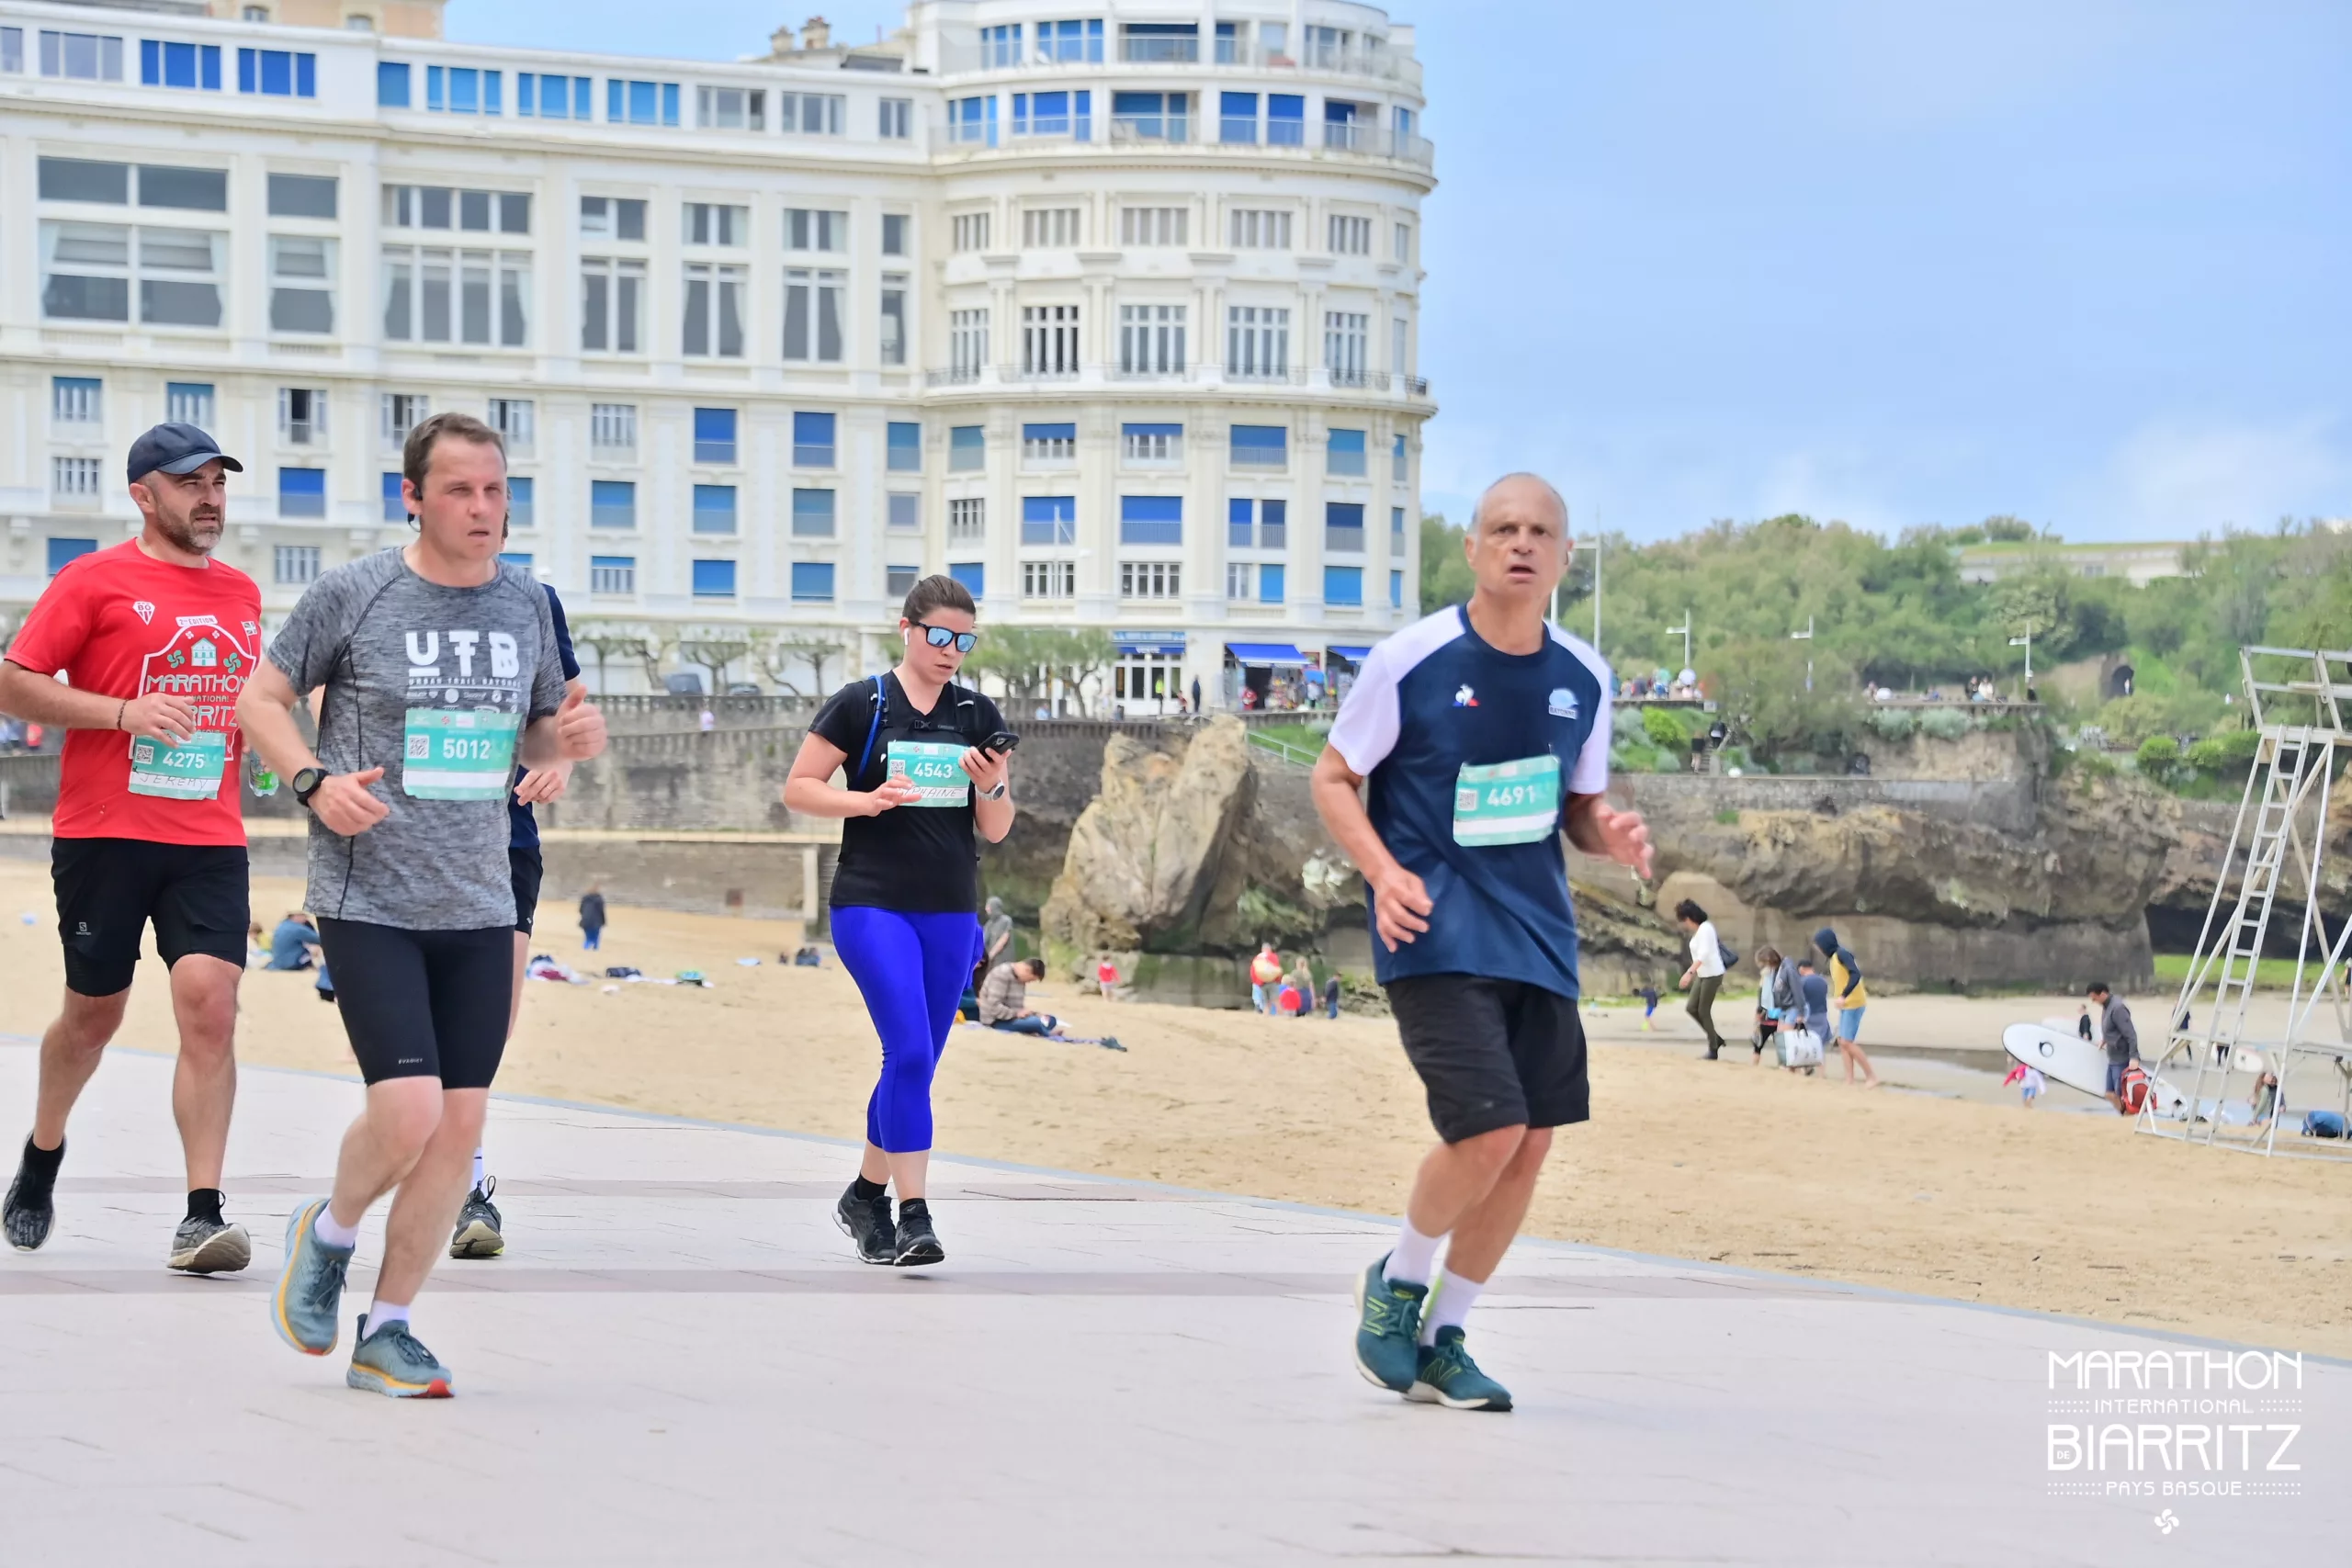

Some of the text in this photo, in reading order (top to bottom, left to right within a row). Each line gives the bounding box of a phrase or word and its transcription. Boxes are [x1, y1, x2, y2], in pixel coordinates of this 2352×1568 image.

[405, 631, 520, 678] UTB
[443, 738, 492, 760] 5012
[163, 751, 205, 769] 4275
[914, 762, 953, 779] 4543
[140, 773, 209, 793] JEREMY
[1487, 785, 1536, 807] 4691
